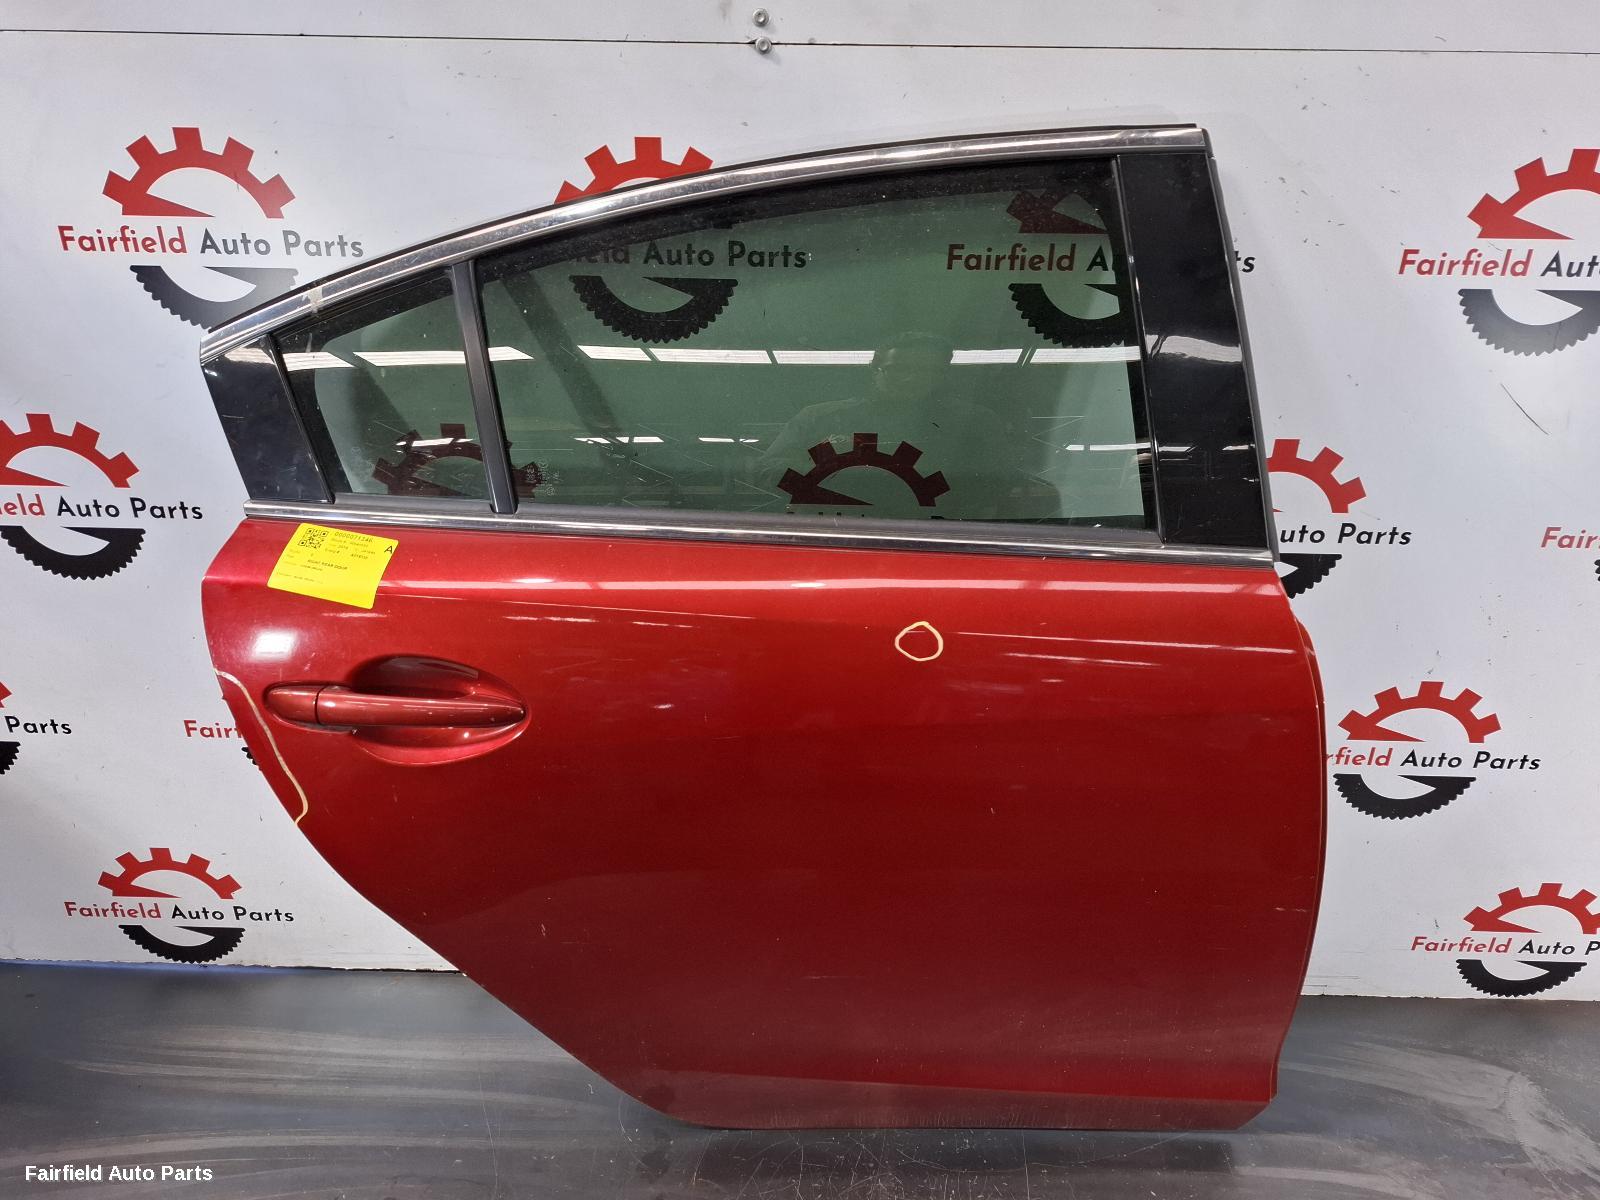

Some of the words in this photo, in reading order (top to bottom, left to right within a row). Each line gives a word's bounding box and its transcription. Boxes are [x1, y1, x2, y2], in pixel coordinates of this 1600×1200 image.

[58, 225, 187, 253] Fairfield
[200, 228, 271, 255] Auto
[283, 230, 363, 257] Parts
[641, 240, 714, 266] Auto
[728, 240, 806, 268] Parts
[947, 243, 1076, 271] Fairfield
[1399, 249, 1533, 276] Fairfield
[1541, 251, 1600, 277] Aut
[58, 496, 119, 517] Auto
[130, 497, 202, 519] Parts
[1280, 525, 1325, 543] uto
[1338, 523, 1411, 545] Parts
[1541, 526, 1600, 549] Fair
[384, 545, 393, 554] A
[4, 716, 72, 735] Parts
[1400, 749, 1462, 767] Auto
[1473, 751, 1540, 769] Parts
[64, 902, 161, 918] Fairfield
[171, 904, 226, 921] Auto
[233, 906, 294, 921] Parts
[1411, 937, 1512, 953] Fairfield
[1518, 940, 1575, 955] Auto
